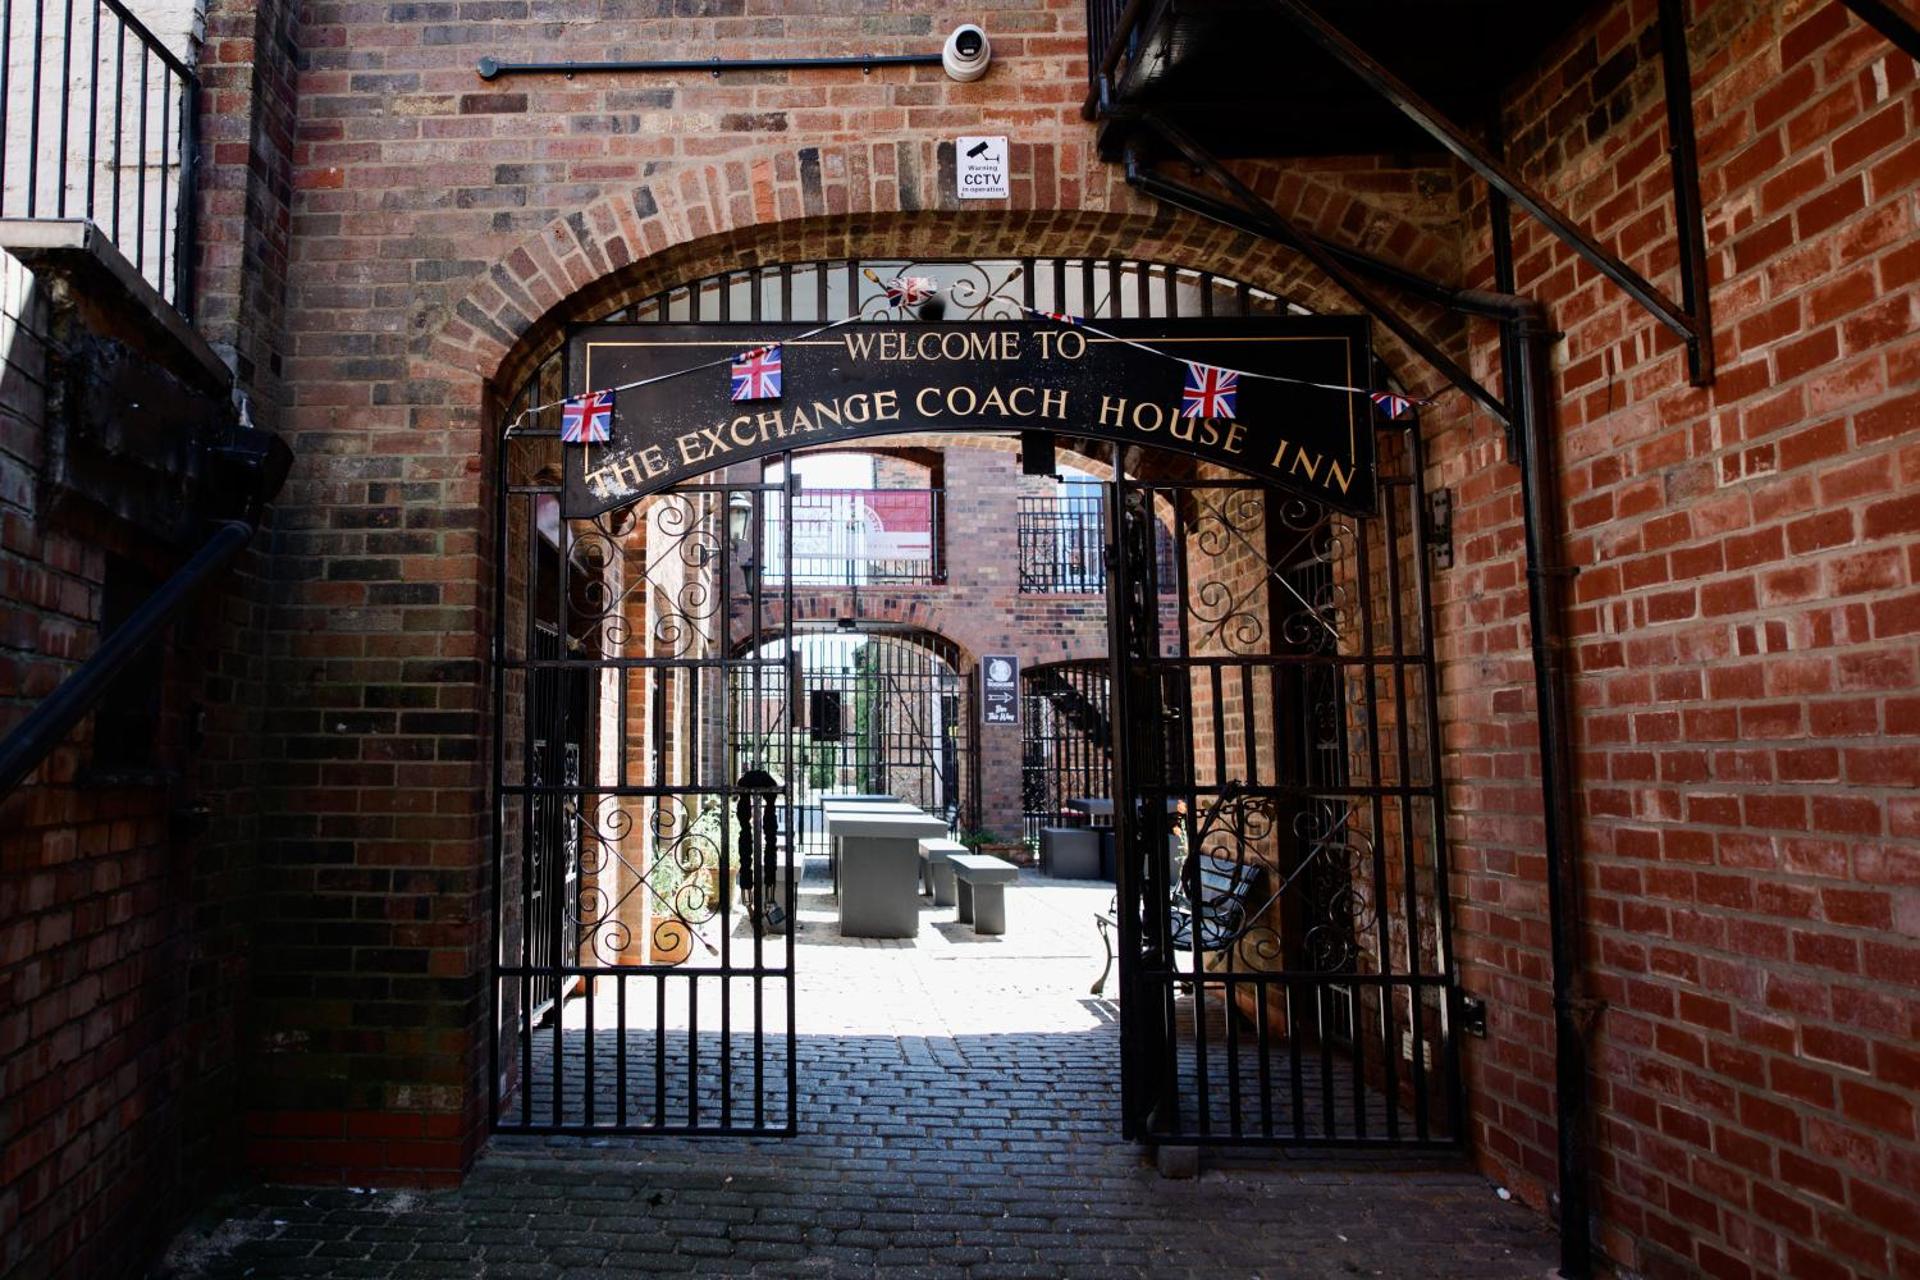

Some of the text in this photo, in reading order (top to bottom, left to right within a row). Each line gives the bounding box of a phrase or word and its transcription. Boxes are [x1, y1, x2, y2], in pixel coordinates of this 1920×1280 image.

[964, 174, 1001, 185] CCTV
[842, 330, 1087, 361] WELCOME TO
[584, 385, 1357, 499] THE EXCHANGE COACH HOUSE INN
